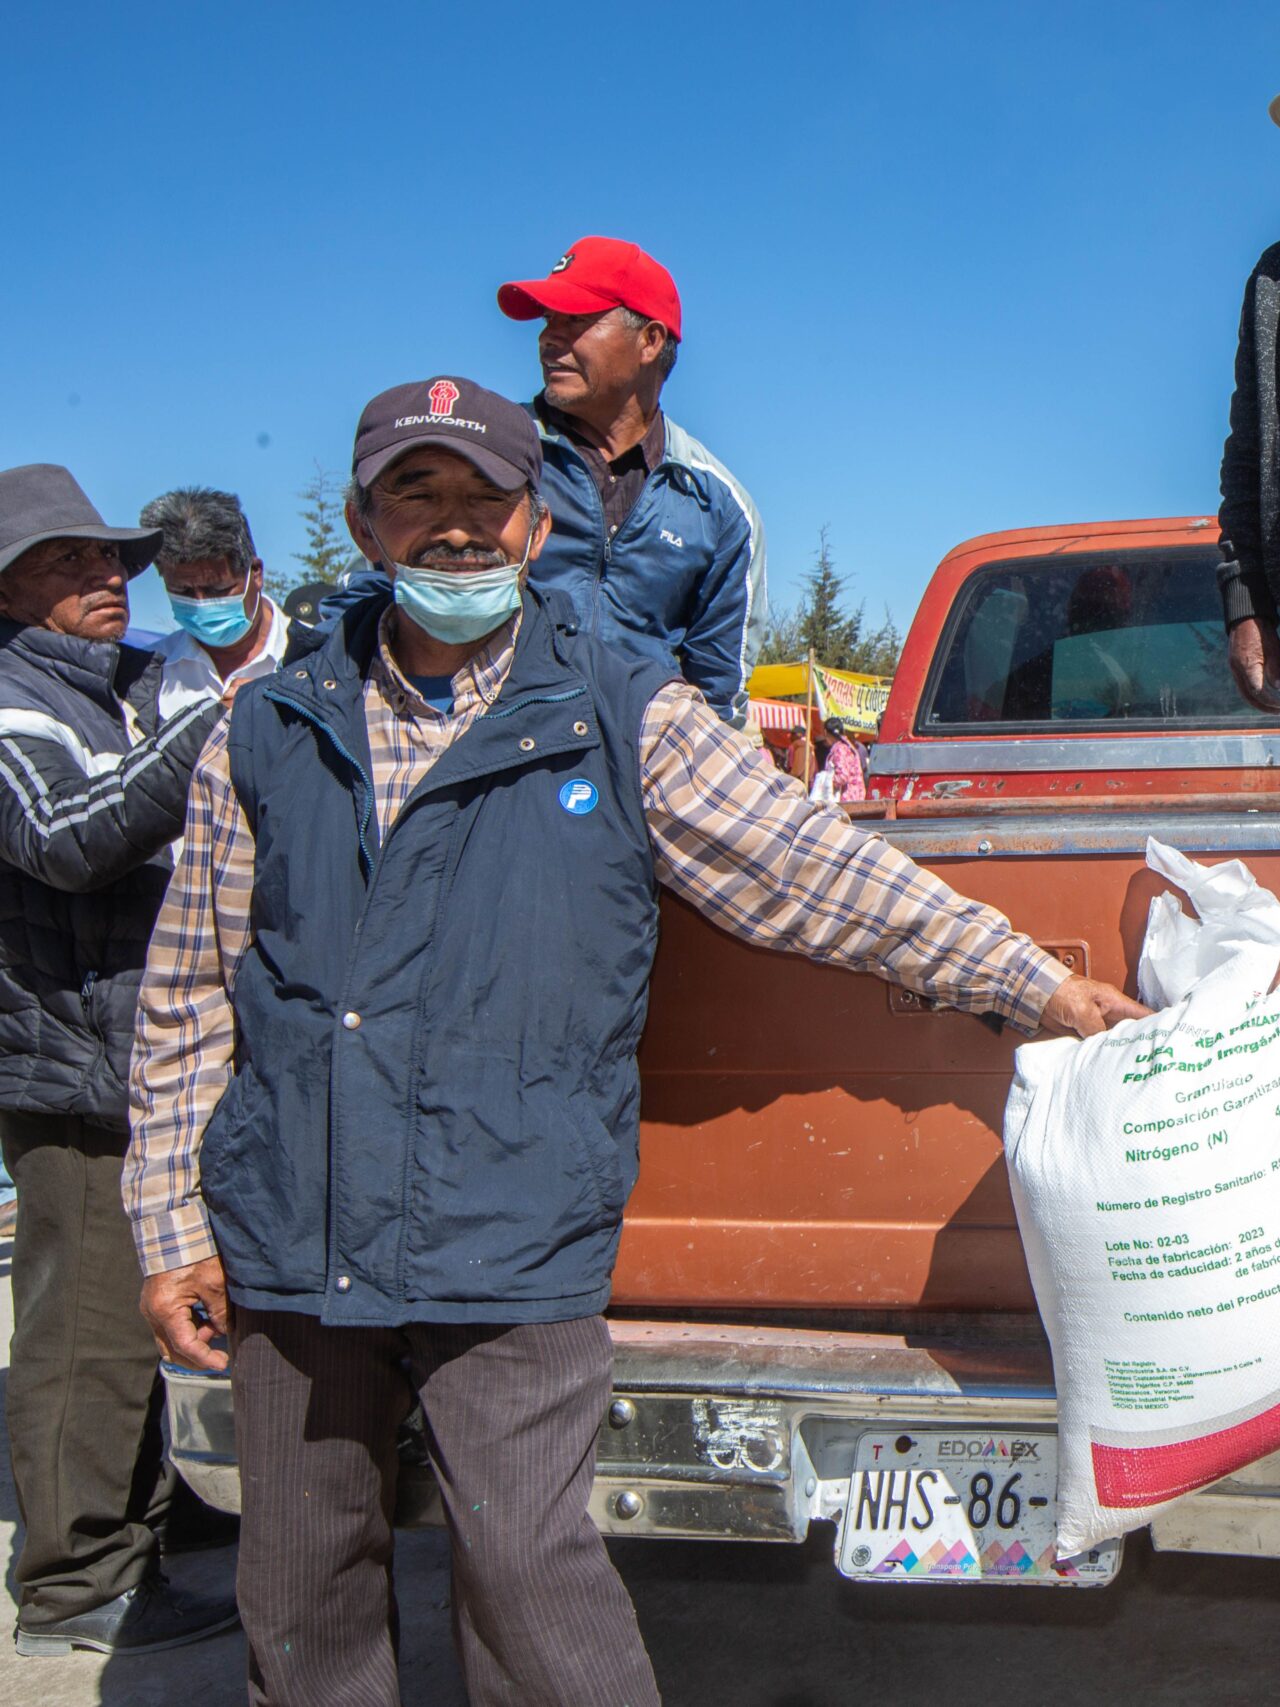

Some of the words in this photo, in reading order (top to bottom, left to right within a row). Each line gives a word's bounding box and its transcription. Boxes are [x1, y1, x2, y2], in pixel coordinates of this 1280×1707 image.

[394, 415, 486, 433] KENWORTH
[660, 529, 683, 547] FILA
[857, 688, 864, 715] y
[1175, 1072, 1254, 1104] Granulado
[1123, 1107, 1219, 1134] Composición
[1126, 1141, 1200, 1163] Nitrógeno
[1207, 1129, 1229, 1150] (N)
[1096, 1201, 1141, 1212] Número
[1144, 1198, 1159, 1208] de
[1162, 1188, 1212, 1206] Registro
[1214, 1168, 1267, 1194] Sanitario:
[1105, 1241, 1131, 1251] Lote
[1133, 1239, 1153, 1250] No:
[1157, 1233, 1190, 1248] 02-03
[1108, 1256, 1142, 1267] Fecha
[1145, 1254, 1160, 1265] de
[1163, 1241, 1233, 1264] fabricación:
[1239, 1226, 1265, 1244] 2023
[1112, 1270, 1147, 1281] Fecha
[1149, 1269, 1164, 1279] de
[1167, 1257, 1233, 1278] caducidad:
[1235, 1251, 1243, 1262] 2
[1245, 1243, 1272, 1259] años
[1235, 1267, 1249, 1278] de
[1124, 1309, 1184, 1323] Contenido
[1187, 1305, 1214, 1318] neto
[1217, 1299, 1235, 1312] del
[873, 1445, 883, 1460] T
[937, 1440, 1039, 1459] EDOMEX
